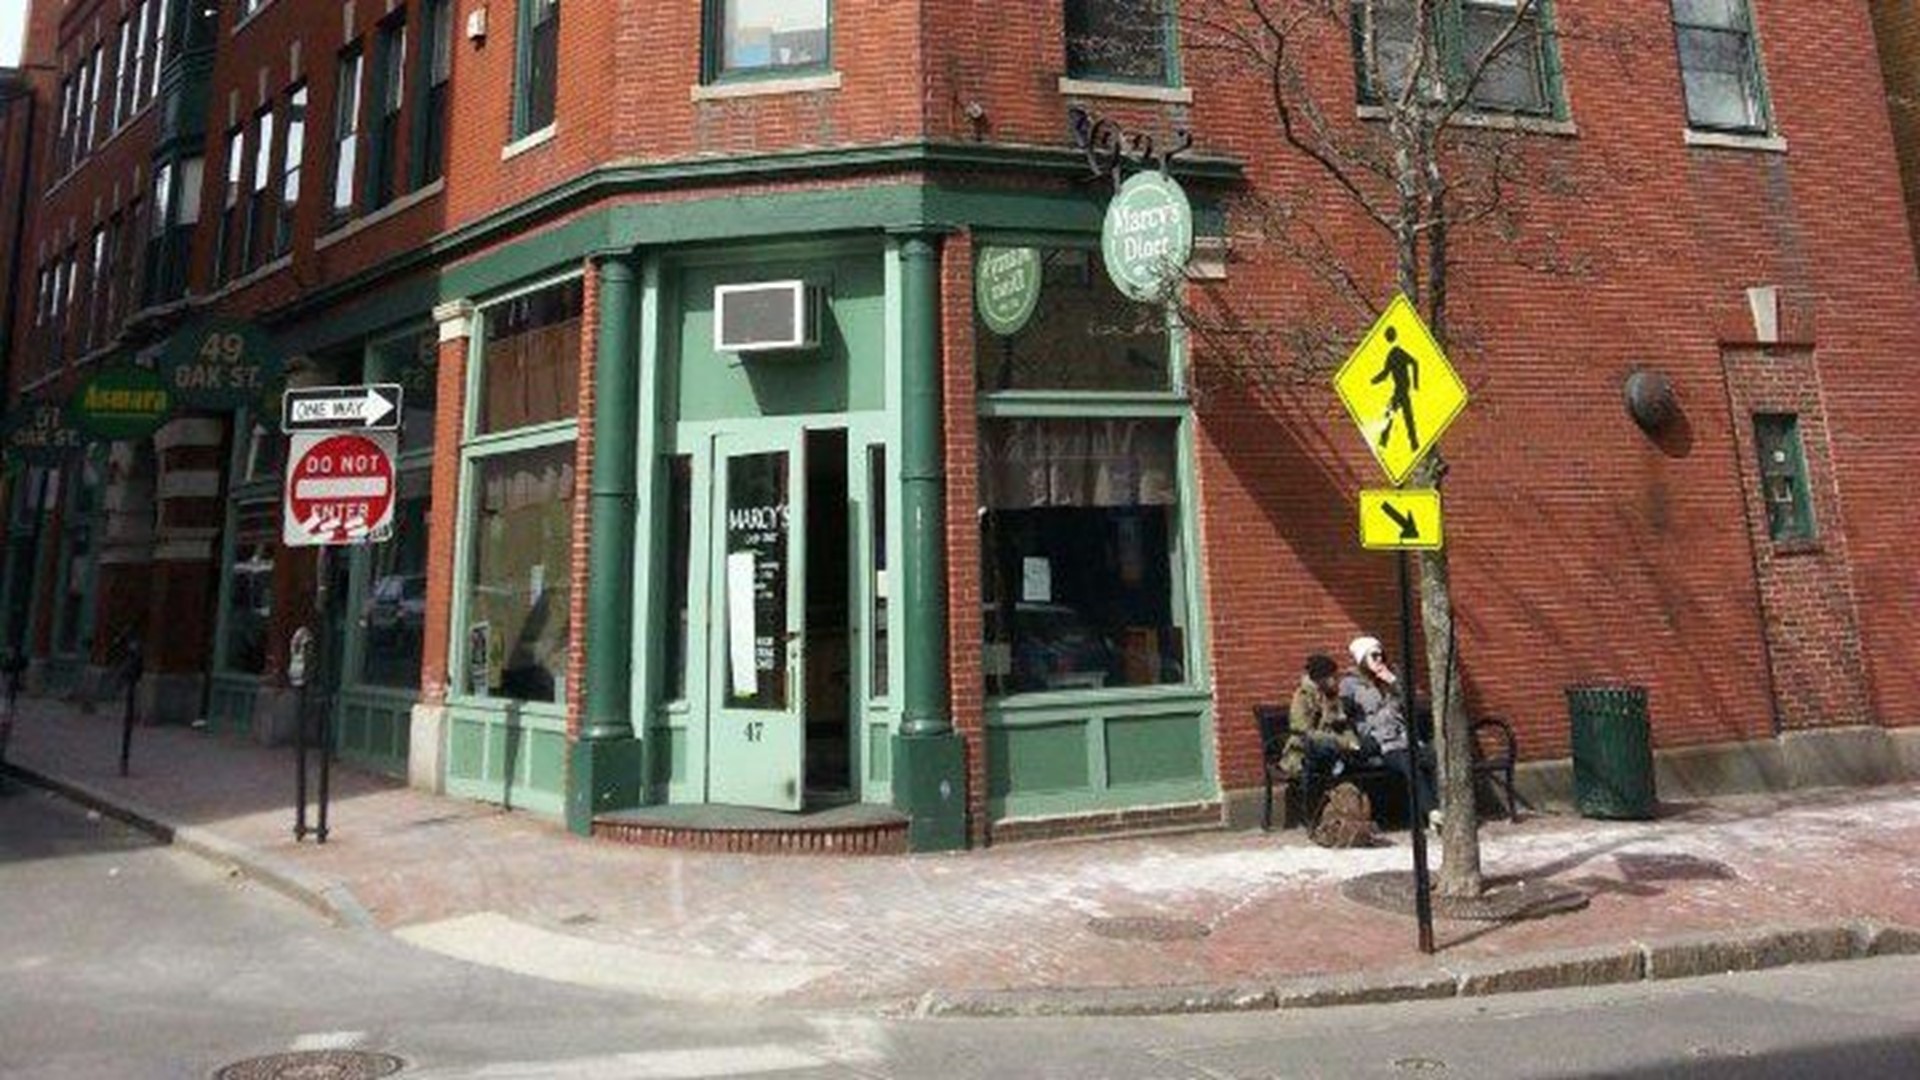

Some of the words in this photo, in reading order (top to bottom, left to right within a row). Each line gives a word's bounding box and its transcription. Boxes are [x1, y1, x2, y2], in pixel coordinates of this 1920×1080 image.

[1112, 202, 1181, 236] Marcy's
[1124, 237, 1169, 262] Diner
[201, 332, 244, 363] 49
[174, 365, 220, 389] OAK
[295, 401, 327, 417] ONE
[331, 400, 366, 416] WAY
[304, 455, 332, 474] DO
[338, 453, 378, 473] NOT
[309, 503, 369, 522] ENTER
[728, 504, 790, 531] MARCY'S
[744, 722, 763, 742] 47
